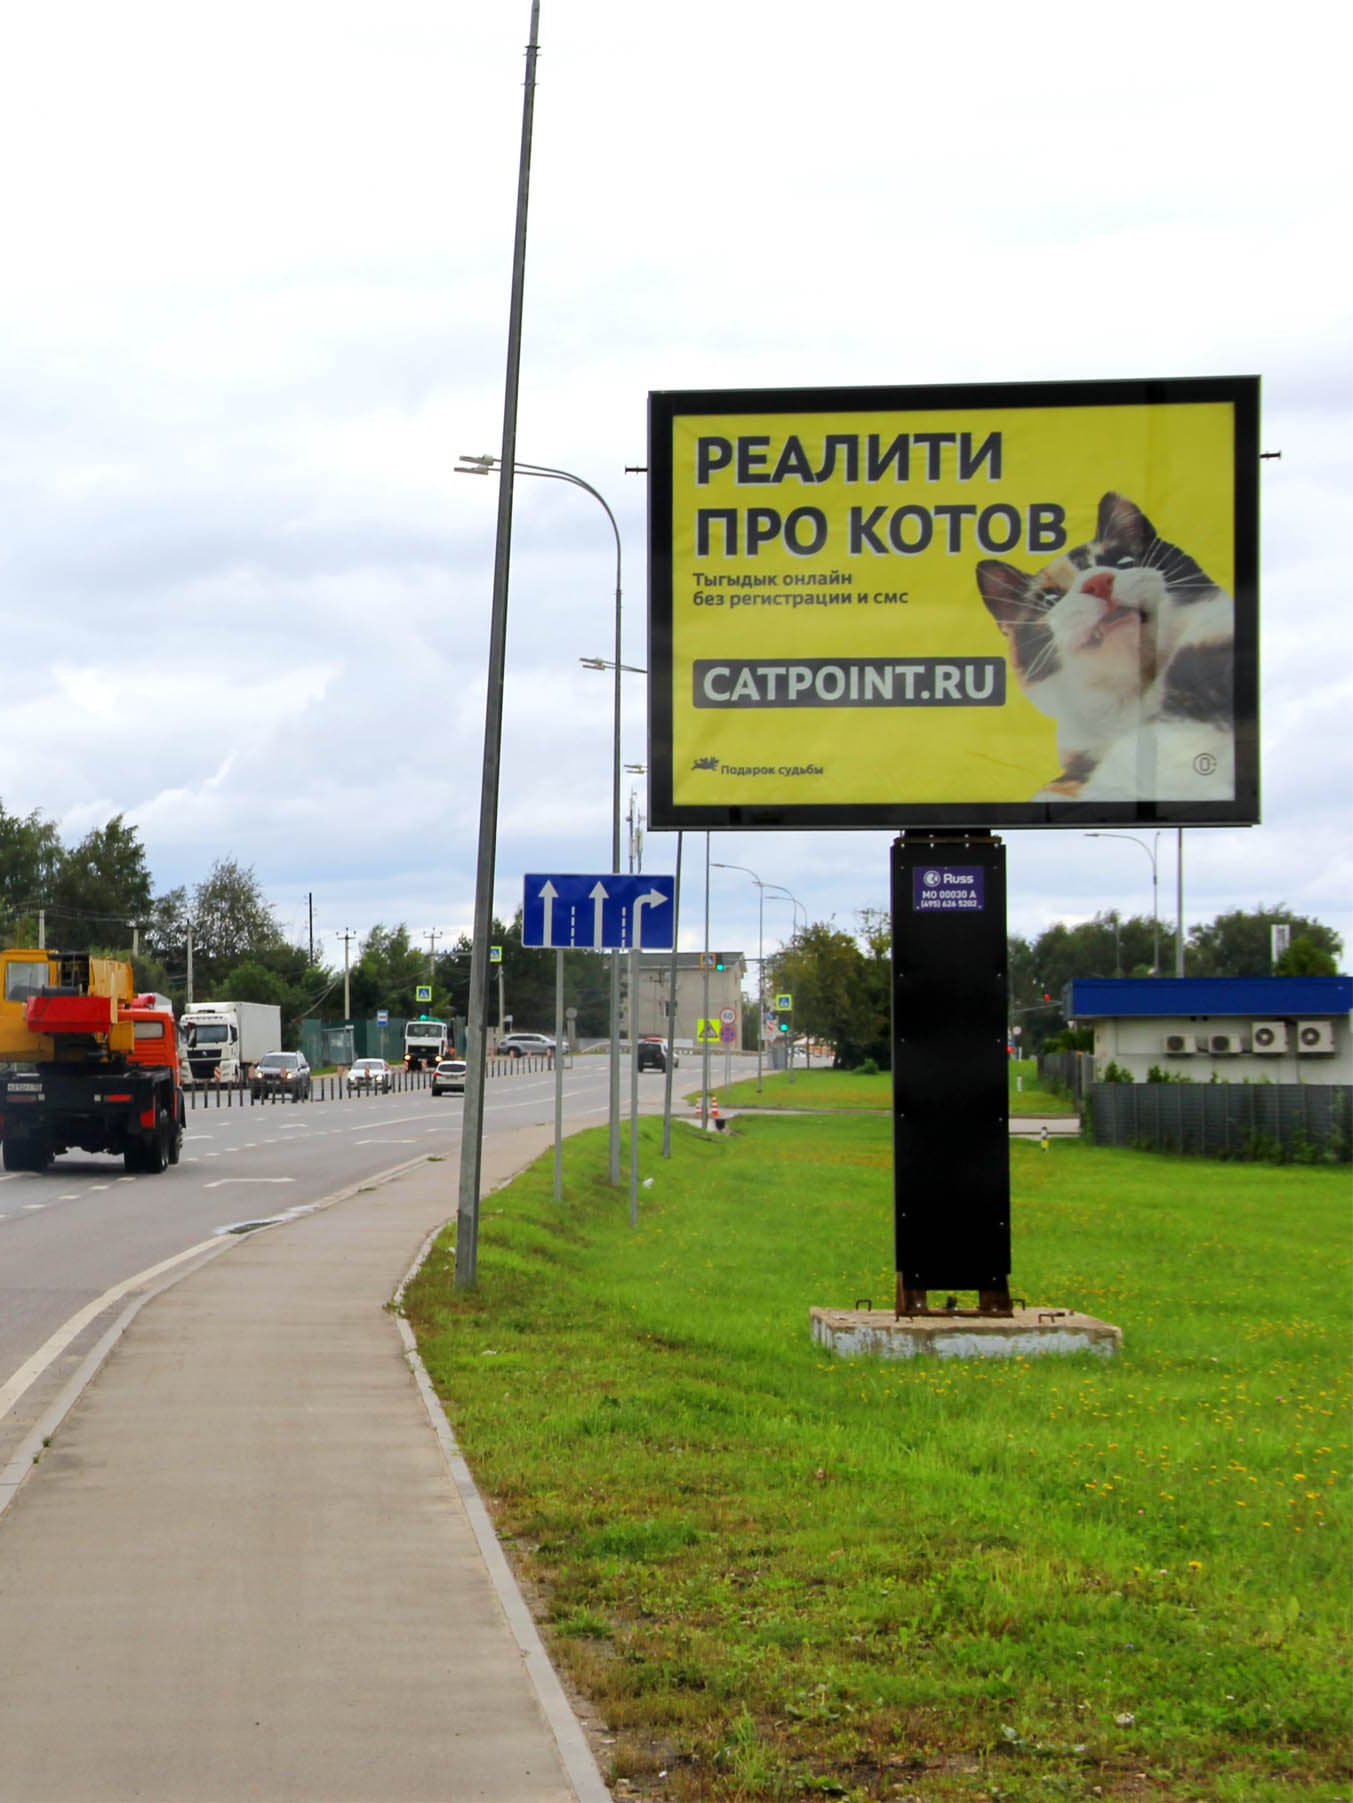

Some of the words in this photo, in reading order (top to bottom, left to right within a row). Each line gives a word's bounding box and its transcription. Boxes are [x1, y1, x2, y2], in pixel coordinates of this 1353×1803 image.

[695, 431, 1003, 486] РЕАЛИТИ
[695, 505, 828, 558] ПРО
[847, 502, 1068, 558] КОТОВ
[692, 571, 777, 588] Тыгыдык
[782, 570, 853, 586] онлайн
[692, 590, 725, 606] без
[729, 591, 853, 608] регистрации
[856, 591, 869, 604] и
[873, 591, 909, 604] смс
[702, 664, 995, 701] CATPOINT.RU
[720, 765, 775, 776] Подарок
[778, 763, 824, 777] судьбы
[943, 873, 974, 884] Russ
[921, 900, 941, 908] (495)
